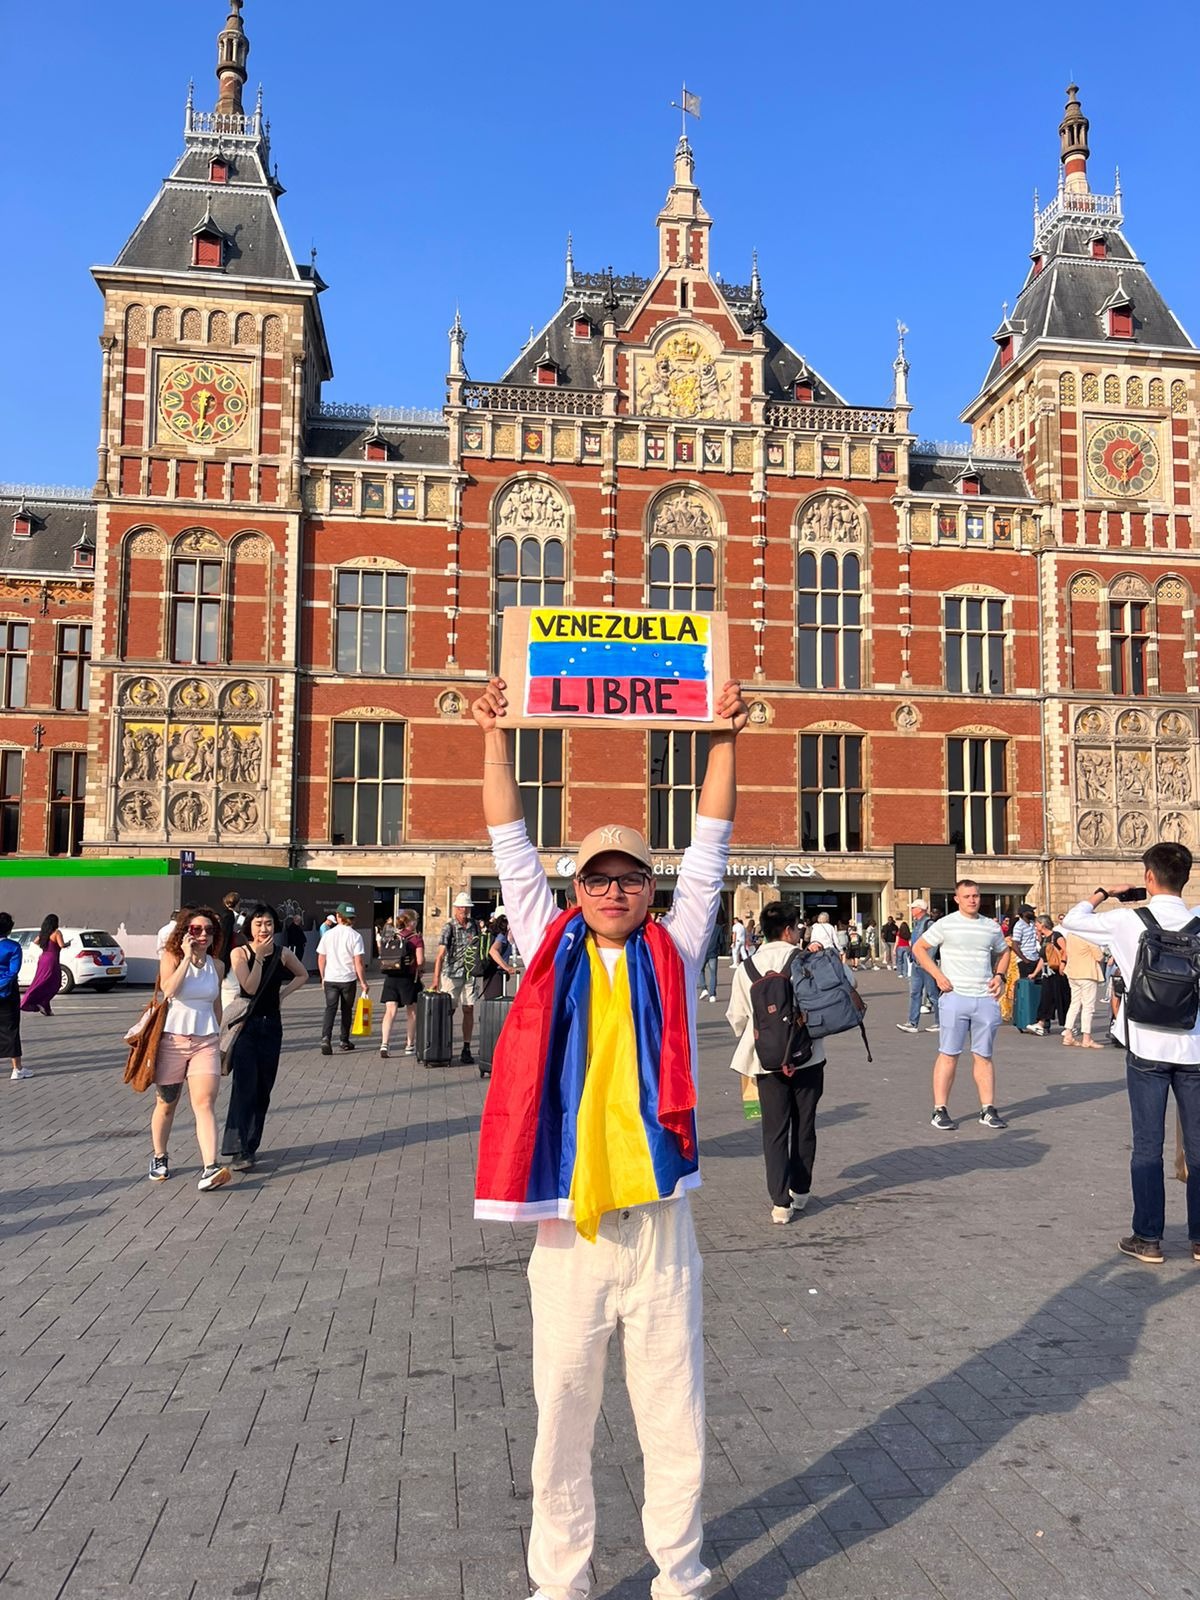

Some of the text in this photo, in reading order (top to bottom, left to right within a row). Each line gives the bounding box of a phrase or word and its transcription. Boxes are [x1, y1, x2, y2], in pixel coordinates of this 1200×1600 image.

[535, 614, 699, 642] VENEZUELA
[551, 677, 680, 715] LIBRE
[726, 862, 773, 877] ntraal
